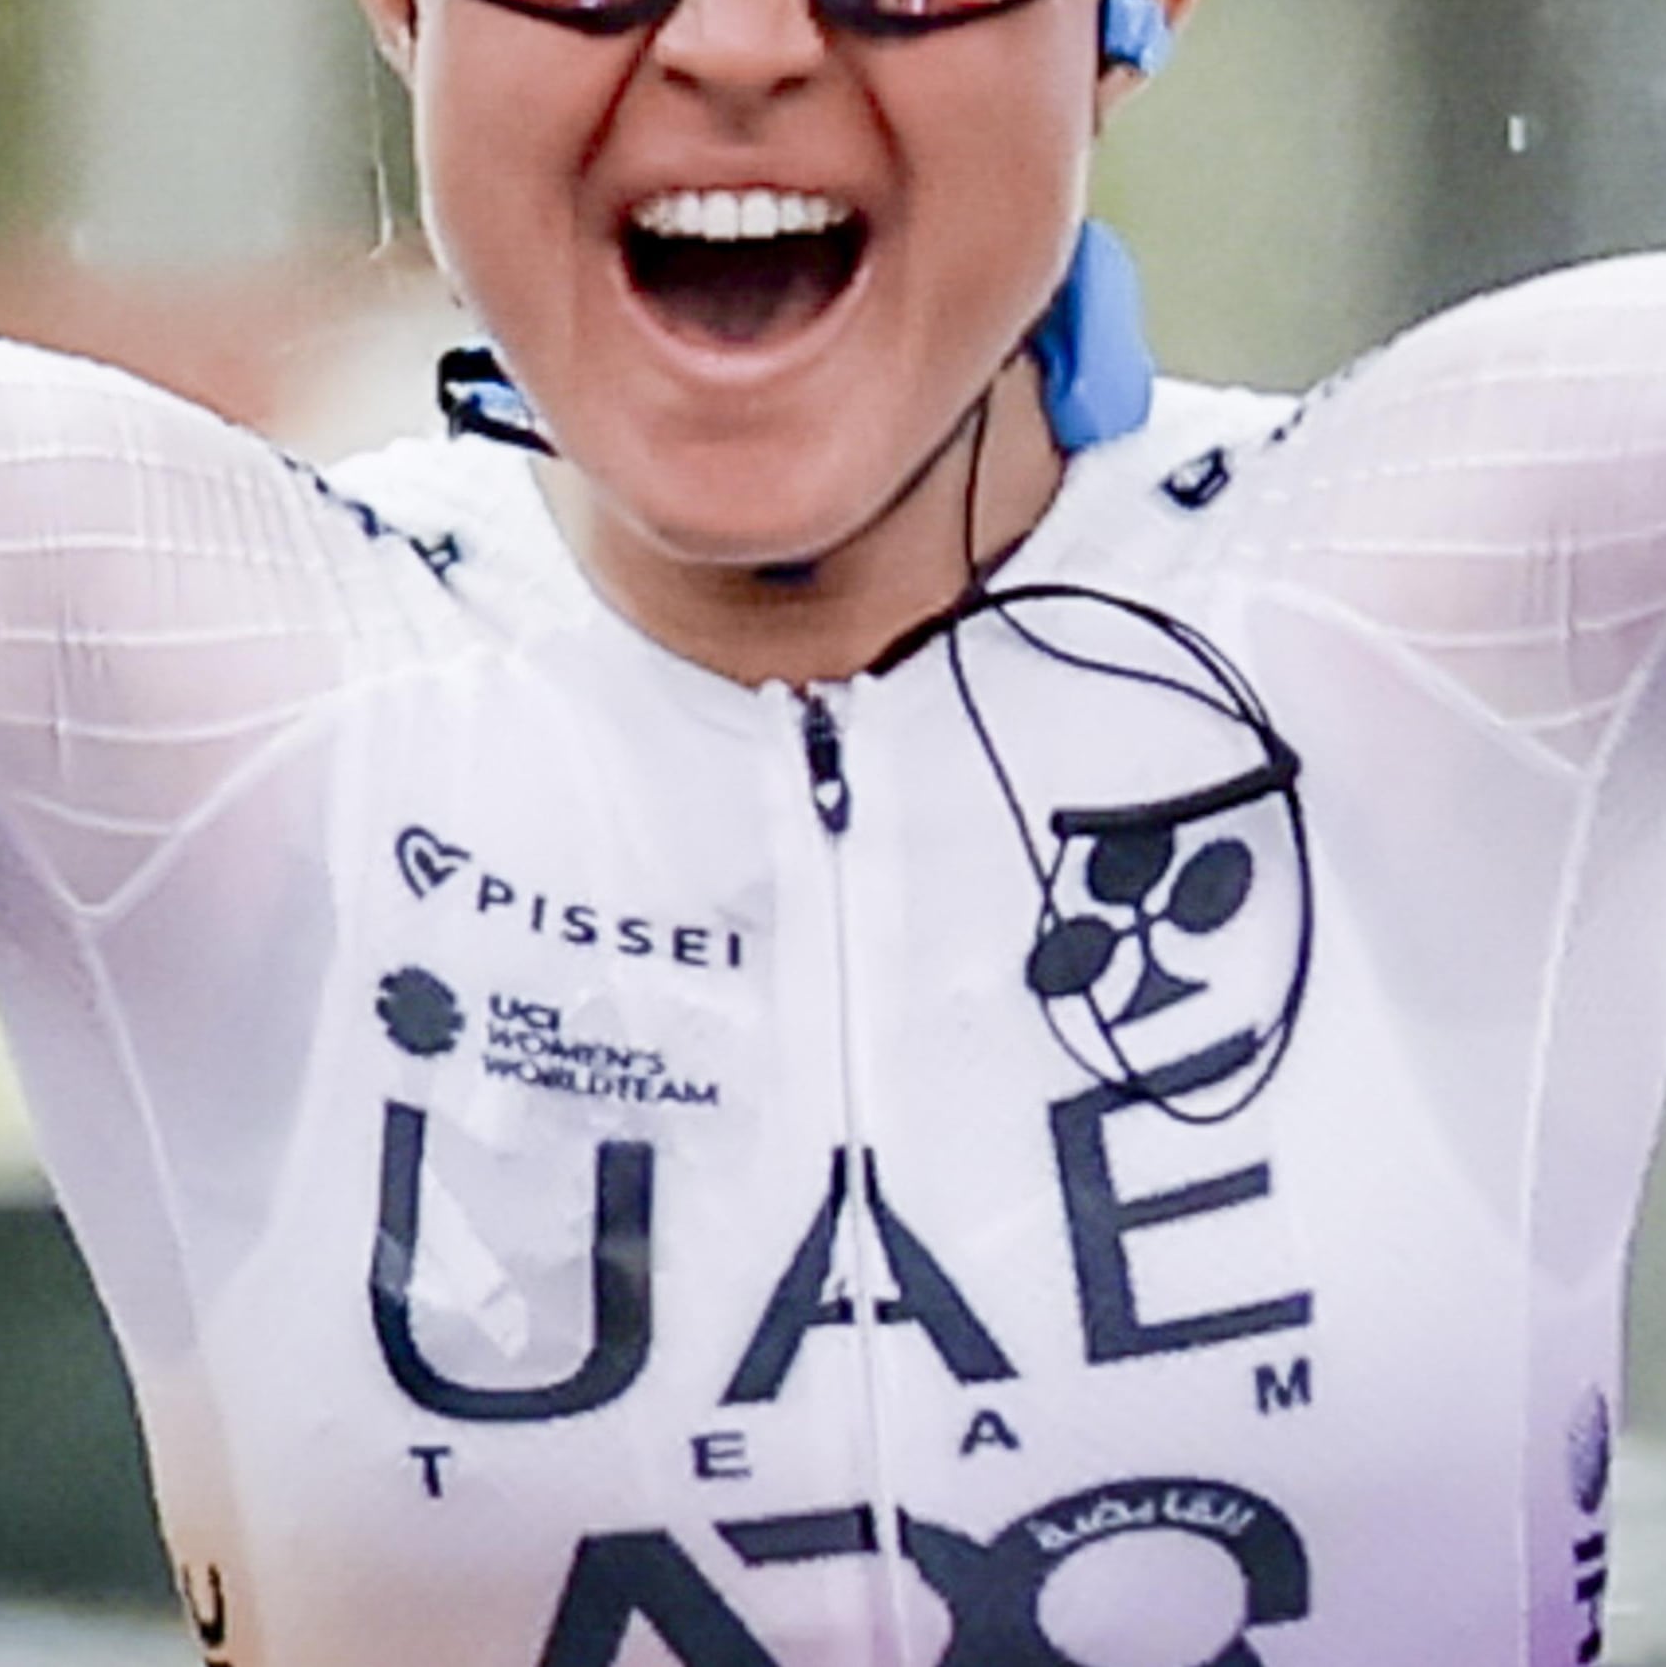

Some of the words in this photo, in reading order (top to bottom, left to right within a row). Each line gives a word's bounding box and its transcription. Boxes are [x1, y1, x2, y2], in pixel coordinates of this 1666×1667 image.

[476, 873, 742, 968] PISSEI
[487, 1022, 666, 1076] WOMEN'S
[489, 993, 561, 1032] UCI
[482, 1054, 719, 1106] WORLDTEAM
[369, 1027, 1313, 1423] UAE
[408, 1358, 1314, 1498] TEAM
